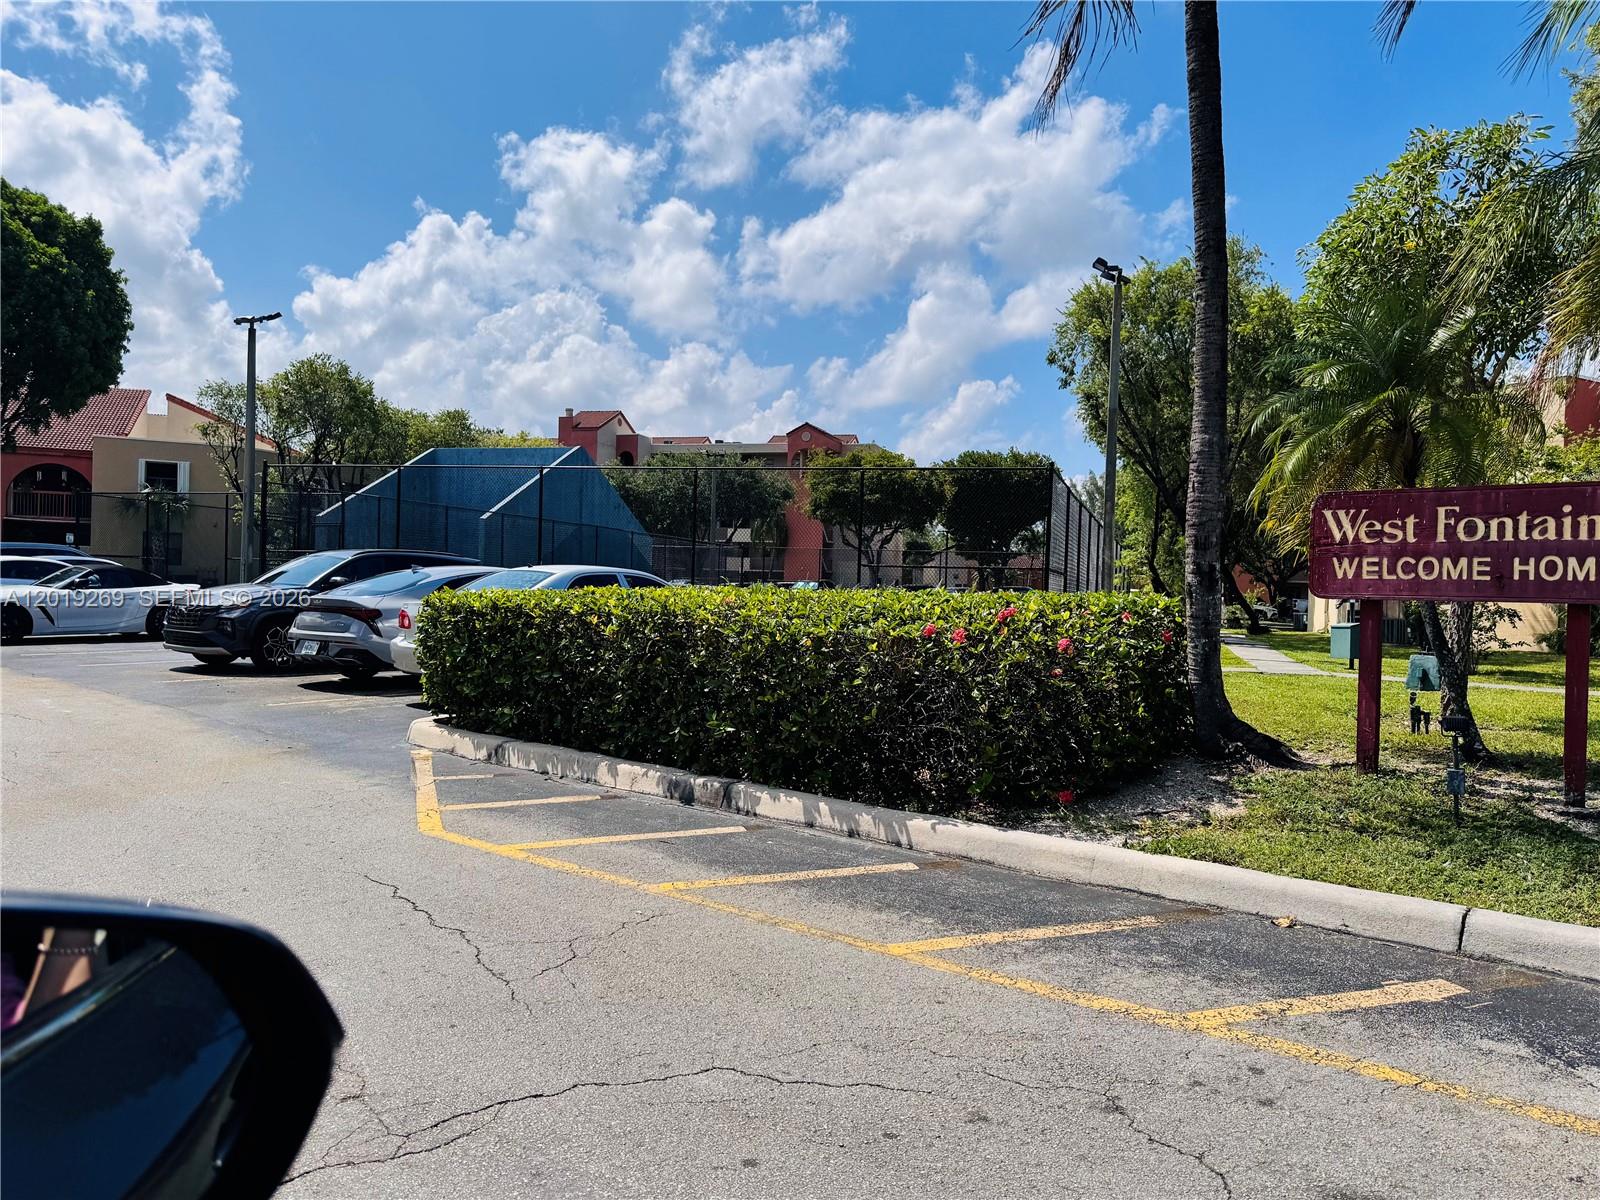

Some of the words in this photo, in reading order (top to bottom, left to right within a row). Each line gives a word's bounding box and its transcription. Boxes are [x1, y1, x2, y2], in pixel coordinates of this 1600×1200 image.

[1322, 509, 1418, 544] West
[1436, 505, 1600, 542] Fontain
[1333, 556, 1491, 581] WELCOME
[1513, 555, 1596, 581] HOM
